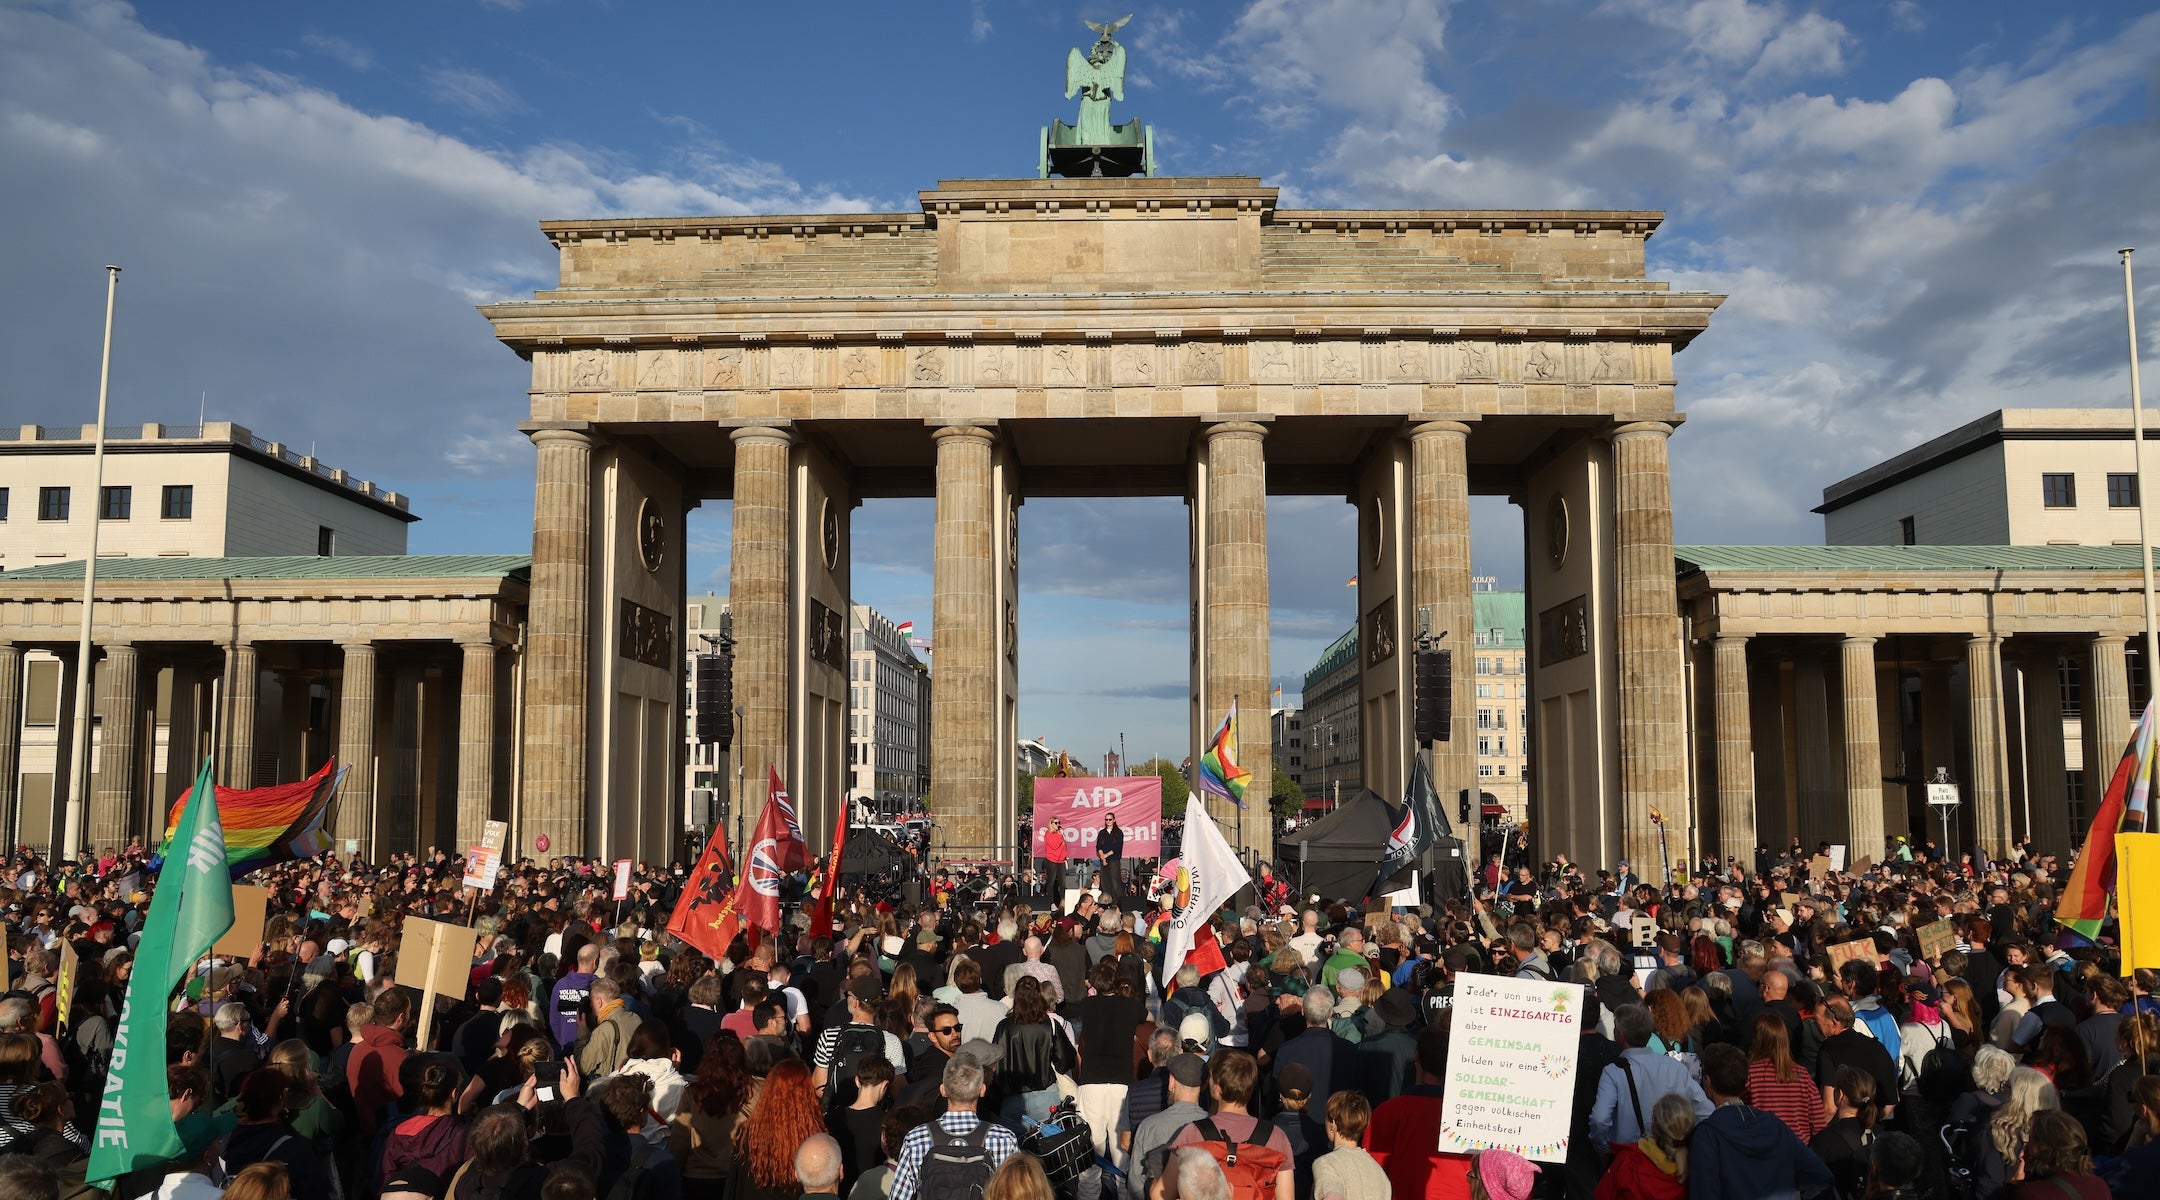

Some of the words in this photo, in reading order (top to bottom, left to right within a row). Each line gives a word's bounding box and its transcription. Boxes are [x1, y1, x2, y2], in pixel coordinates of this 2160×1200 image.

[1071, 786, 1122, 808] AfD
[1038, 821, 1157, 847] sopen!
[1833, 942, 1874, 961] FUCK
[1504, 992, 1521, 1001] von
[1526, 994, 1542, 1003] uns
[1470, 1006, 1484, 1015] ist
[1490, 1007, 1572, 1024] EINZIGARTIG
[1465, 1020, 1487, 1031] aber
[1468, 1036, 1542, 1053] GEMEINSAM
[1461, 1055, 1493, 1066] bilden
[1500, 1060, 1513, 1069] wir
[1518, 1062, 1538, 1071] eine
[1455, 1072, 1515, 1088] SOLIDAR-
[1459, 1089, 1556, 1110] GEMEINSCHAFT
[1455, 1102, 1486, 1116] gegen
[1491, 1106, 1541, 1120] völkischen
[1456, 1118, 1522, 1136] Einheitsbrei!
